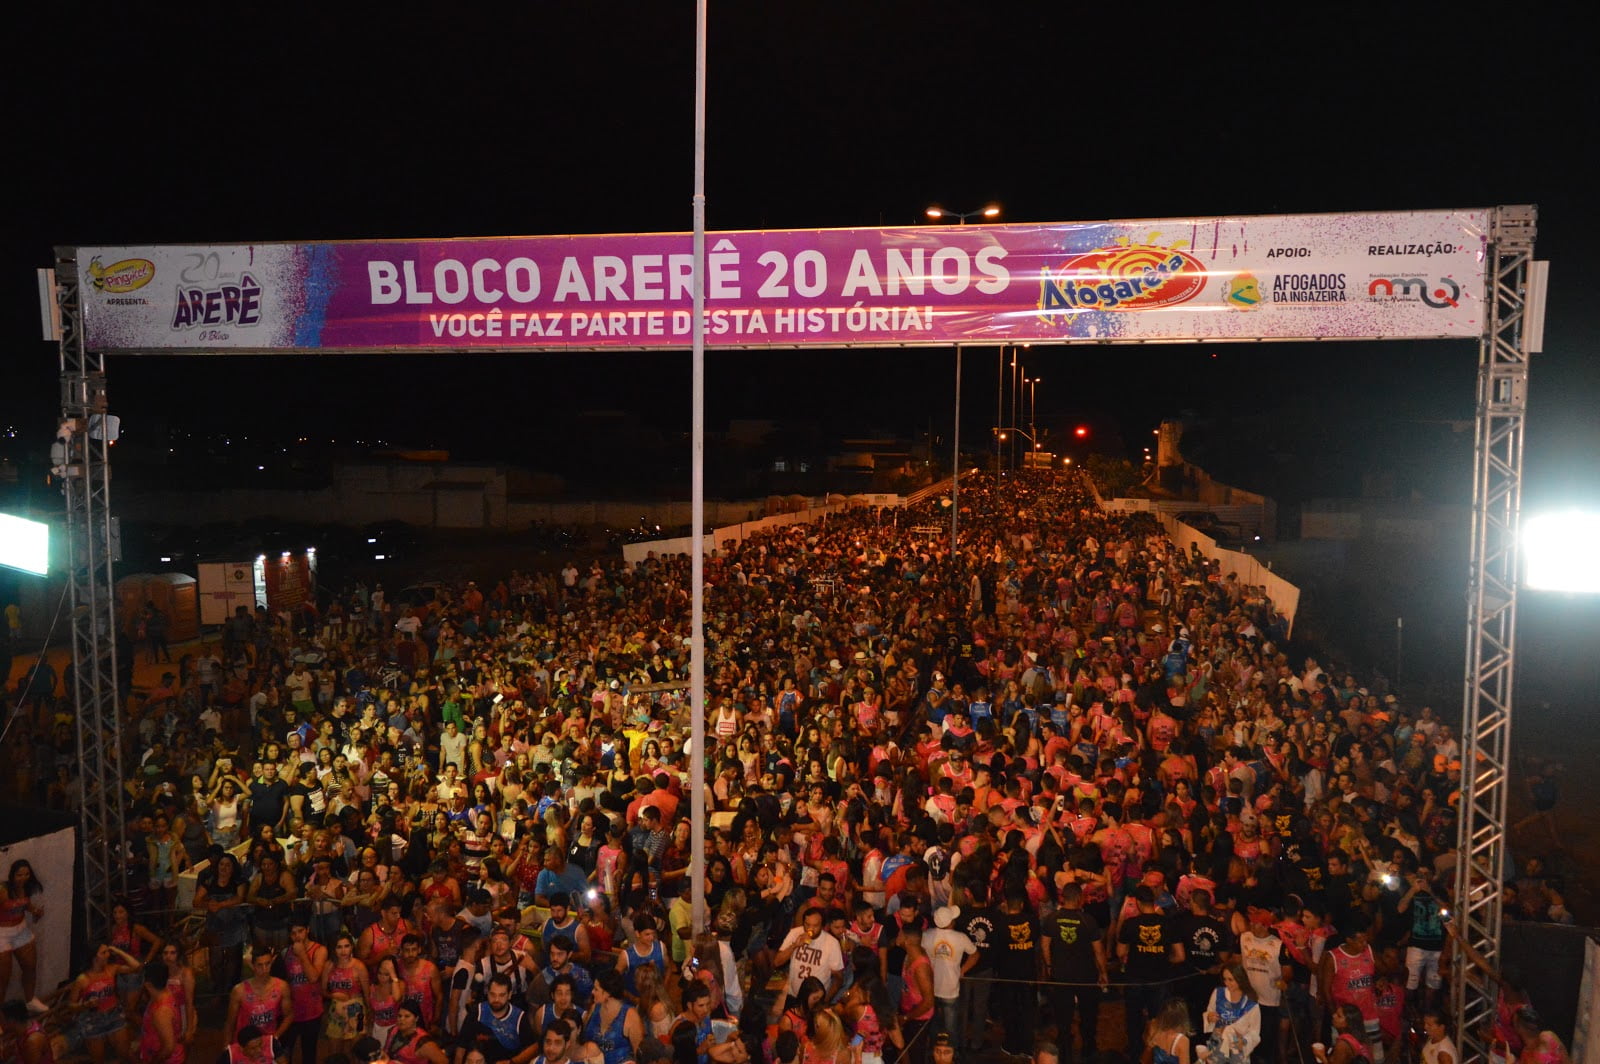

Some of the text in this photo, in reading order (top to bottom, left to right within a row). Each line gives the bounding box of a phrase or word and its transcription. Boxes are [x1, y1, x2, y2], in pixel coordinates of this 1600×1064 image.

[1267, 247, 1311, 258] APOIO:
[1368, 241, 1457, 258] REALIZAÇÃO:
[180, 252, 220, 283] 20
[367, 238, 1011, 305] BLOCO ARERÊ 20 ANOS
[1273, 273, 1346, 290] AFOGADOS
[173, 275, 261, 328] ARERÊ
[1273, 291, 1347, 302] DA INGAZEIRA
[429, 307, 503, 337] VOCÊ
[510, 312, 563, 337] FAZ
[570, 311, 664, 337] PARTE
[774, 301, 933, 333] HISTÓRIA!
[1136, 944, 1164, 953] TIGER
